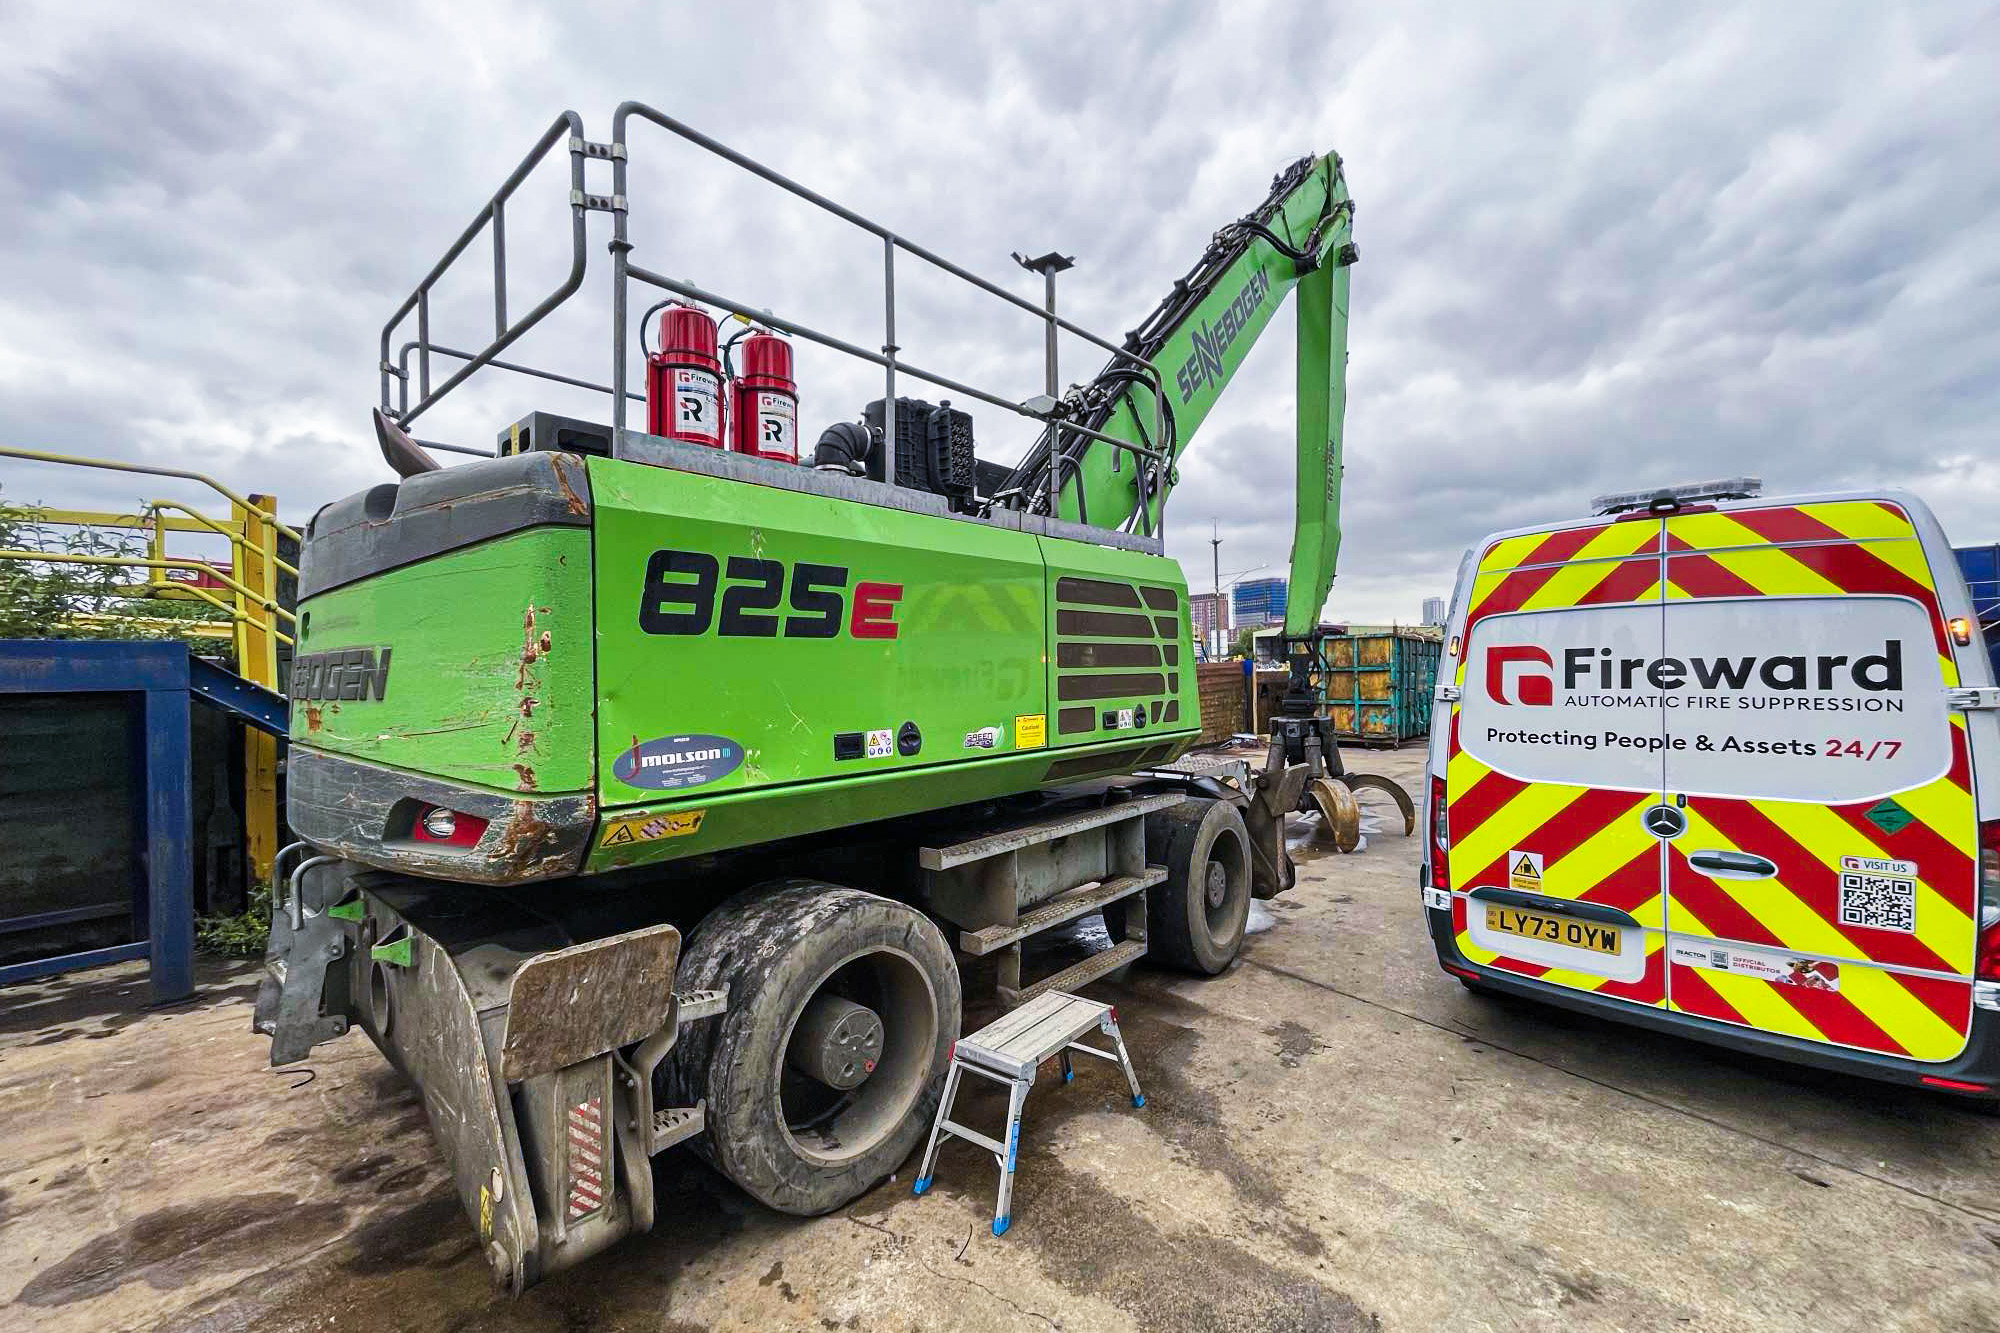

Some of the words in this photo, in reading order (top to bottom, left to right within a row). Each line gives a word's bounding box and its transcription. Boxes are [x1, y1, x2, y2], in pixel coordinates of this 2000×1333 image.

[638, 549, 904, 640] 825E
[1564, 640, 1903, 691] Fireward
[1565, 695, 1680, 708] AUTOMATIC
[1687, 696, 1731, 709] FIRE
[1738, 697, 1904, 712] SUPPRESSION
[1487, 727, 1597, 750] Protecting
[1604, 731, 1687, 752] People
[1695, 734, 1716, 752] &
[1720, 735, 1817, 756] Assets
[1825, 738, 1903, 761] 24/7
[1863, 860, 1889, 871] VISIT
[1892, 863, 1907, 873] US
[1500, 910, 1560, 940] LY73
[1567, 923, 1616, 952] OYW
[1732, 956, 1766, 967] OFFICIAL
